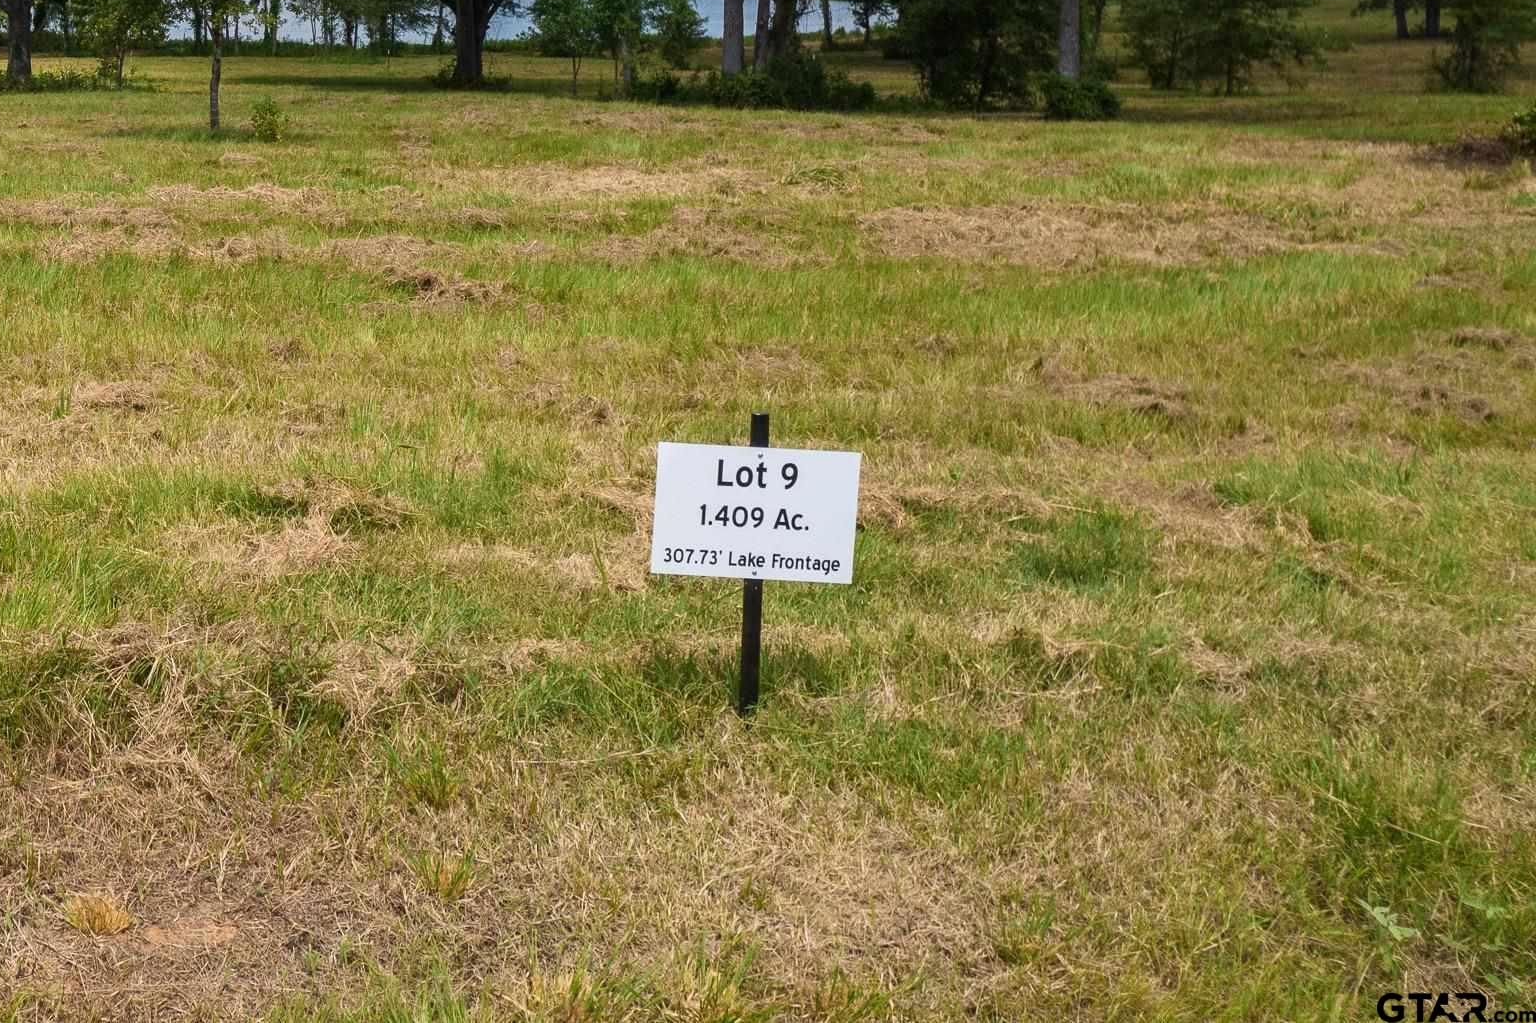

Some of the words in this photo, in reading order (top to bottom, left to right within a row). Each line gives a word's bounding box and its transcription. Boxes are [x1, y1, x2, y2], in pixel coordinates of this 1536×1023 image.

[717, 459, 767, 488] Lot
[781, 463, 799, 490] 9
[699, 504, 765, 528] 1.409
[773, 508, 809, 531] Ac.
[663, 547, 723, 565] 307.73'
[728, 552, 765, 568] Lake
[771, 554, 841, 575] Frontage
